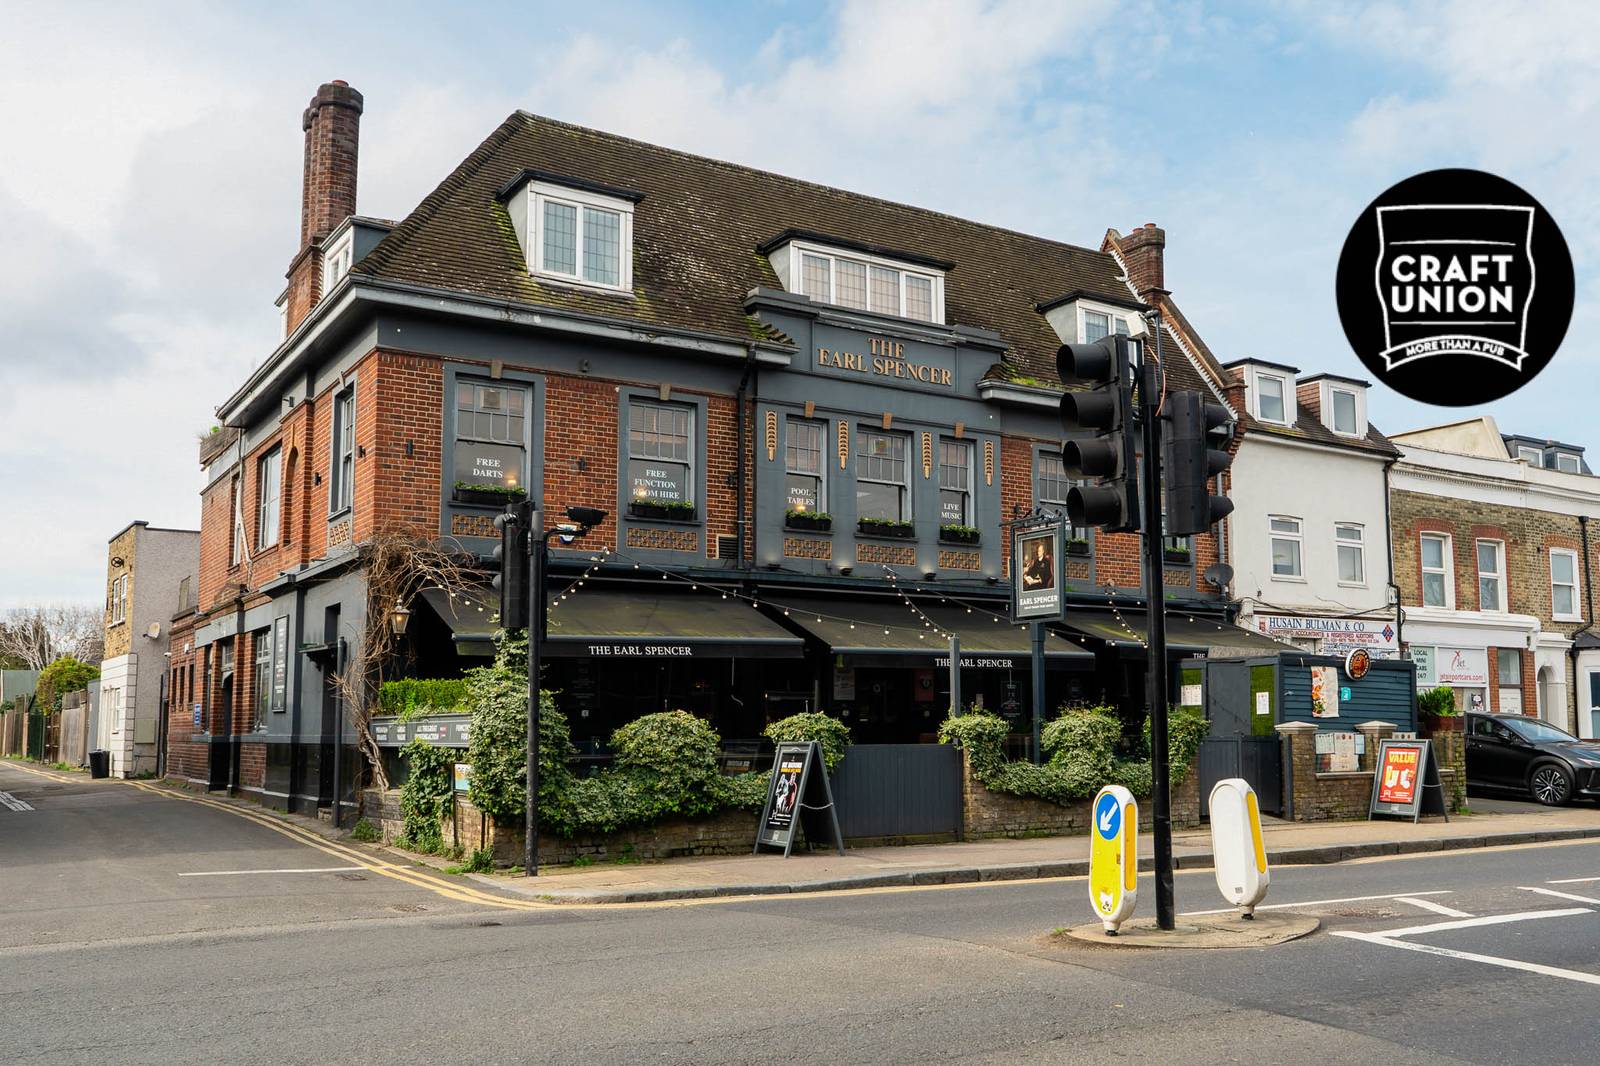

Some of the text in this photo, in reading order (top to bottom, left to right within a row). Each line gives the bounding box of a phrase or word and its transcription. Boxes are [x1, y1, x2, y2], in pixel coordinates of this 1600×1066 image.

[868, 337, 905, 359] THE
[818, 348, 952, 386] EARL SPENCER
[476, 457, 501, 468] FREE
[473, 468, 503, 479] DARTS
[646, 469, 667, 478] FREE
[634, 478, 676, 489] FUNCTION
[660, 490, 680, 500] HIRE
[791, 487, 811, 496] POOL
[787, 496, 815, 505] TABLES
[943, 502, 960, 511] LIVE
[941, 511, 962, 520] MUSIC
[1020, 595, 1058, 606] EARL SPENCER
[1269, 617, 1302, 629] HUSAIN
[1306, 619, 1341, 631] BULMAN
[1345, 622, 1350, 630] &
[1354, 622, 1365, 631] CO
[589, 646, 692, 656] THE EARL SPENCER
[935, 658, 1013, 668] THE ARL SPENCER
[1389, 751, 1416, 763] VALUE
